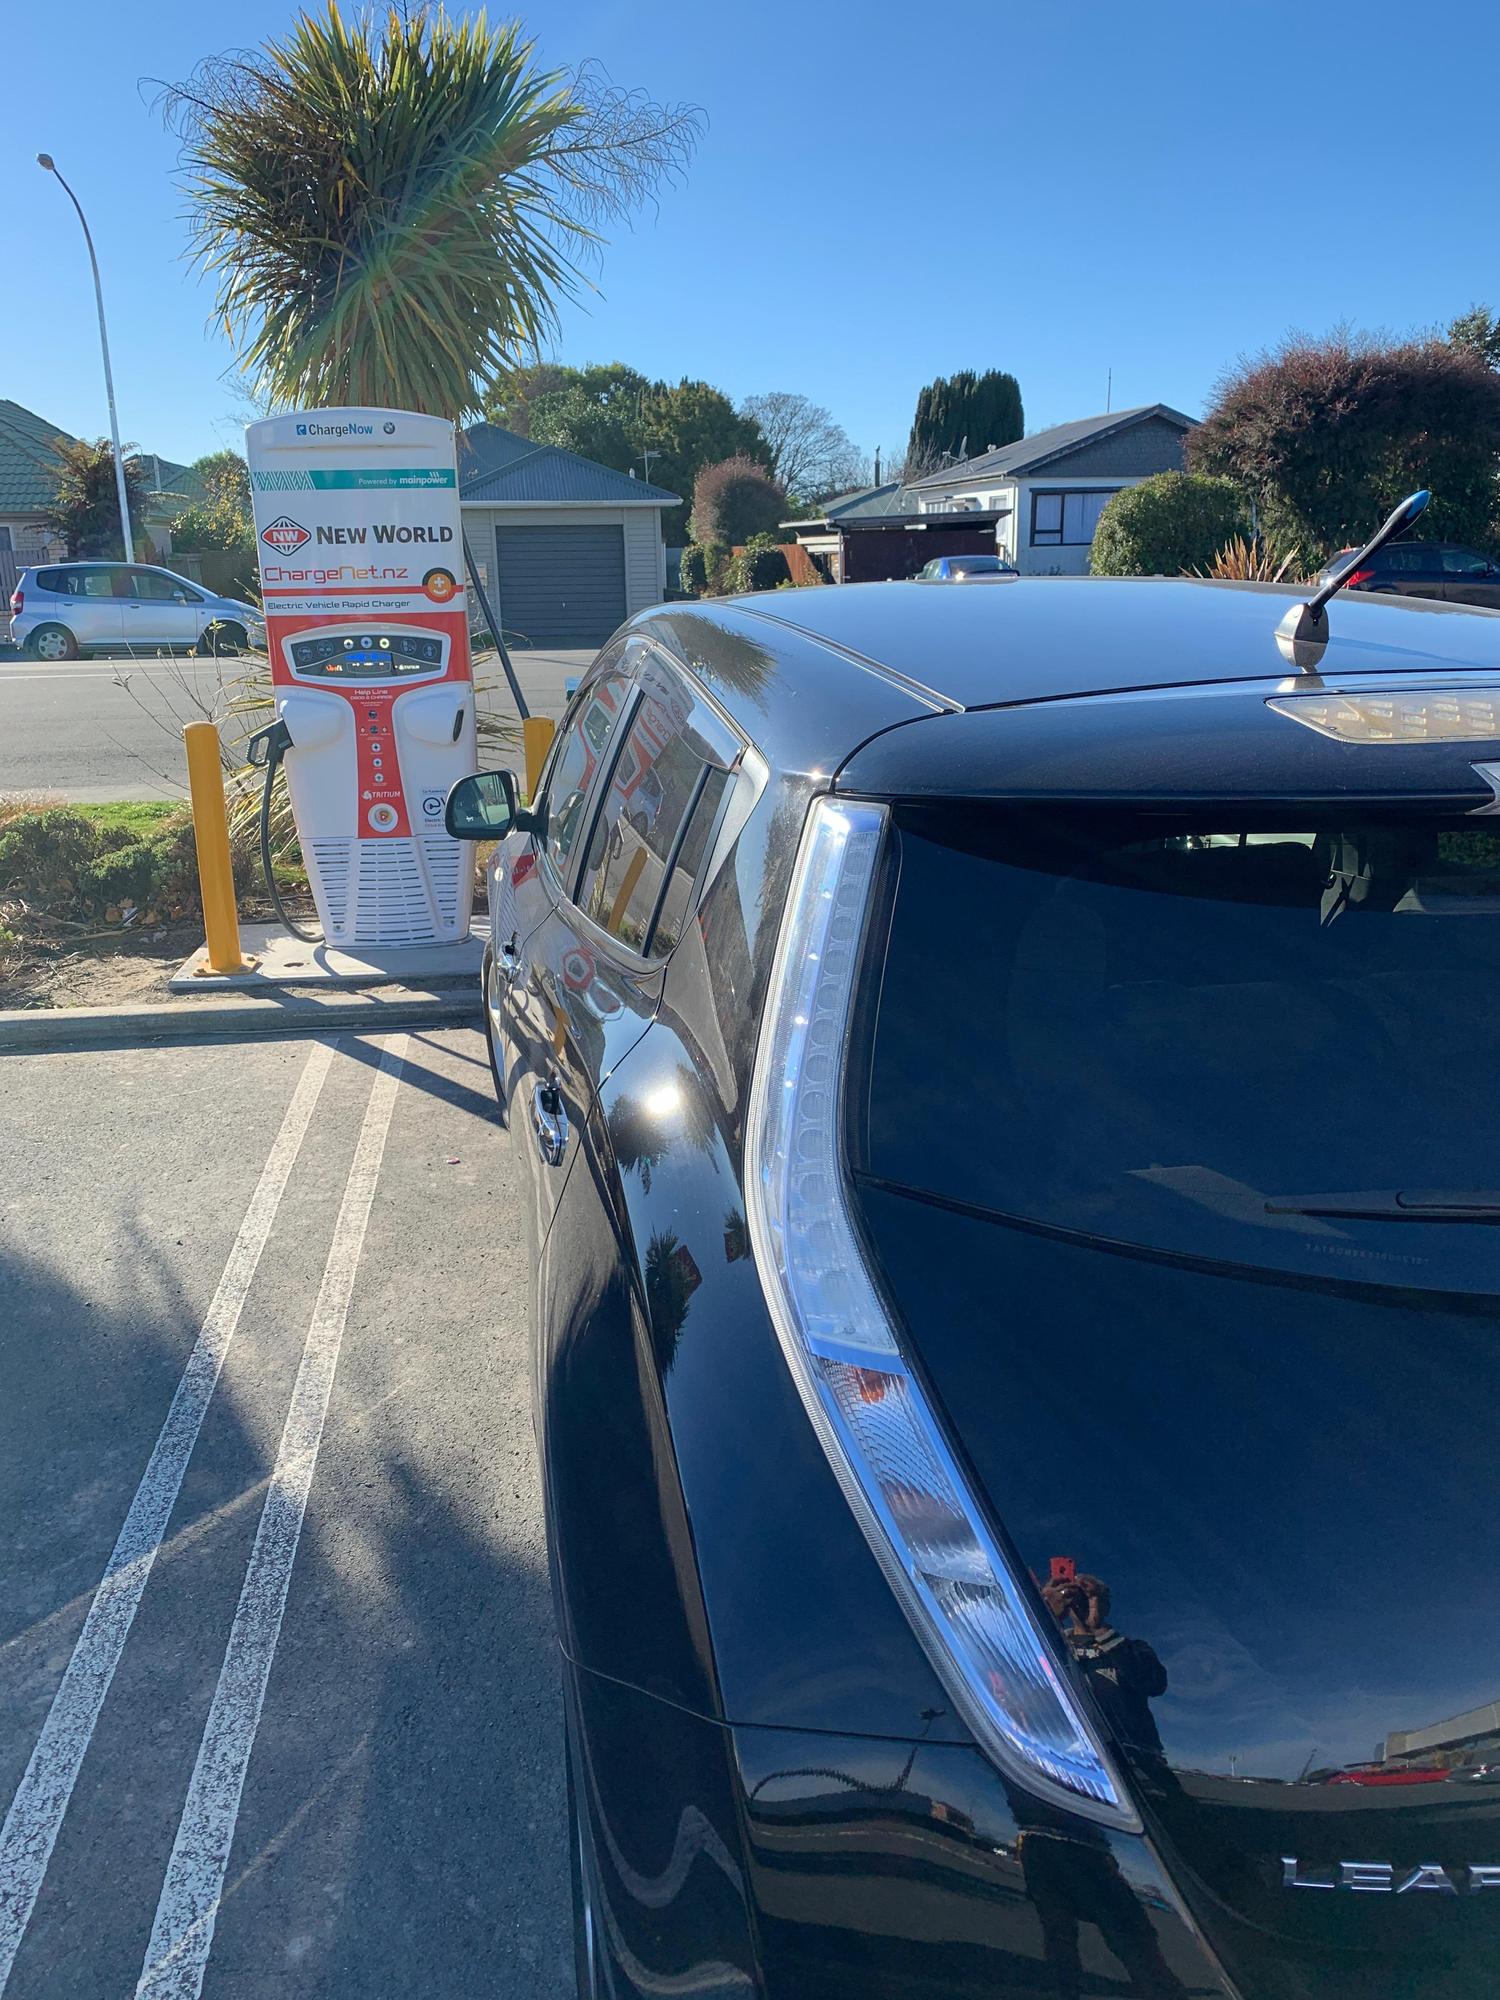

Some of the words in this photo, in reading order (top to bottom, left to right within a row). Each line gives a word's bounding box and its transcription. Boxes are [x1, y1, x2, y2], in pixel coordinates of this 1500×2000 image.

[309, 423, 373, 437] ChargeNow
[388, 478, 397, 486] by
[399, 472, 448, 486] mainpower
[272, 531, 299, 543] NW
[316, 526, 367, 545] NEW
[372, 525, 453, 544] WORLD
[264, 564, 409, 584] ChargeNet.nz
[267, 602, 303, 610] Electric
[305, 601, 340, 609] Vehicle
[341, 600, 370, 609] Rapid
[371, 600, 411, 609] Charger
